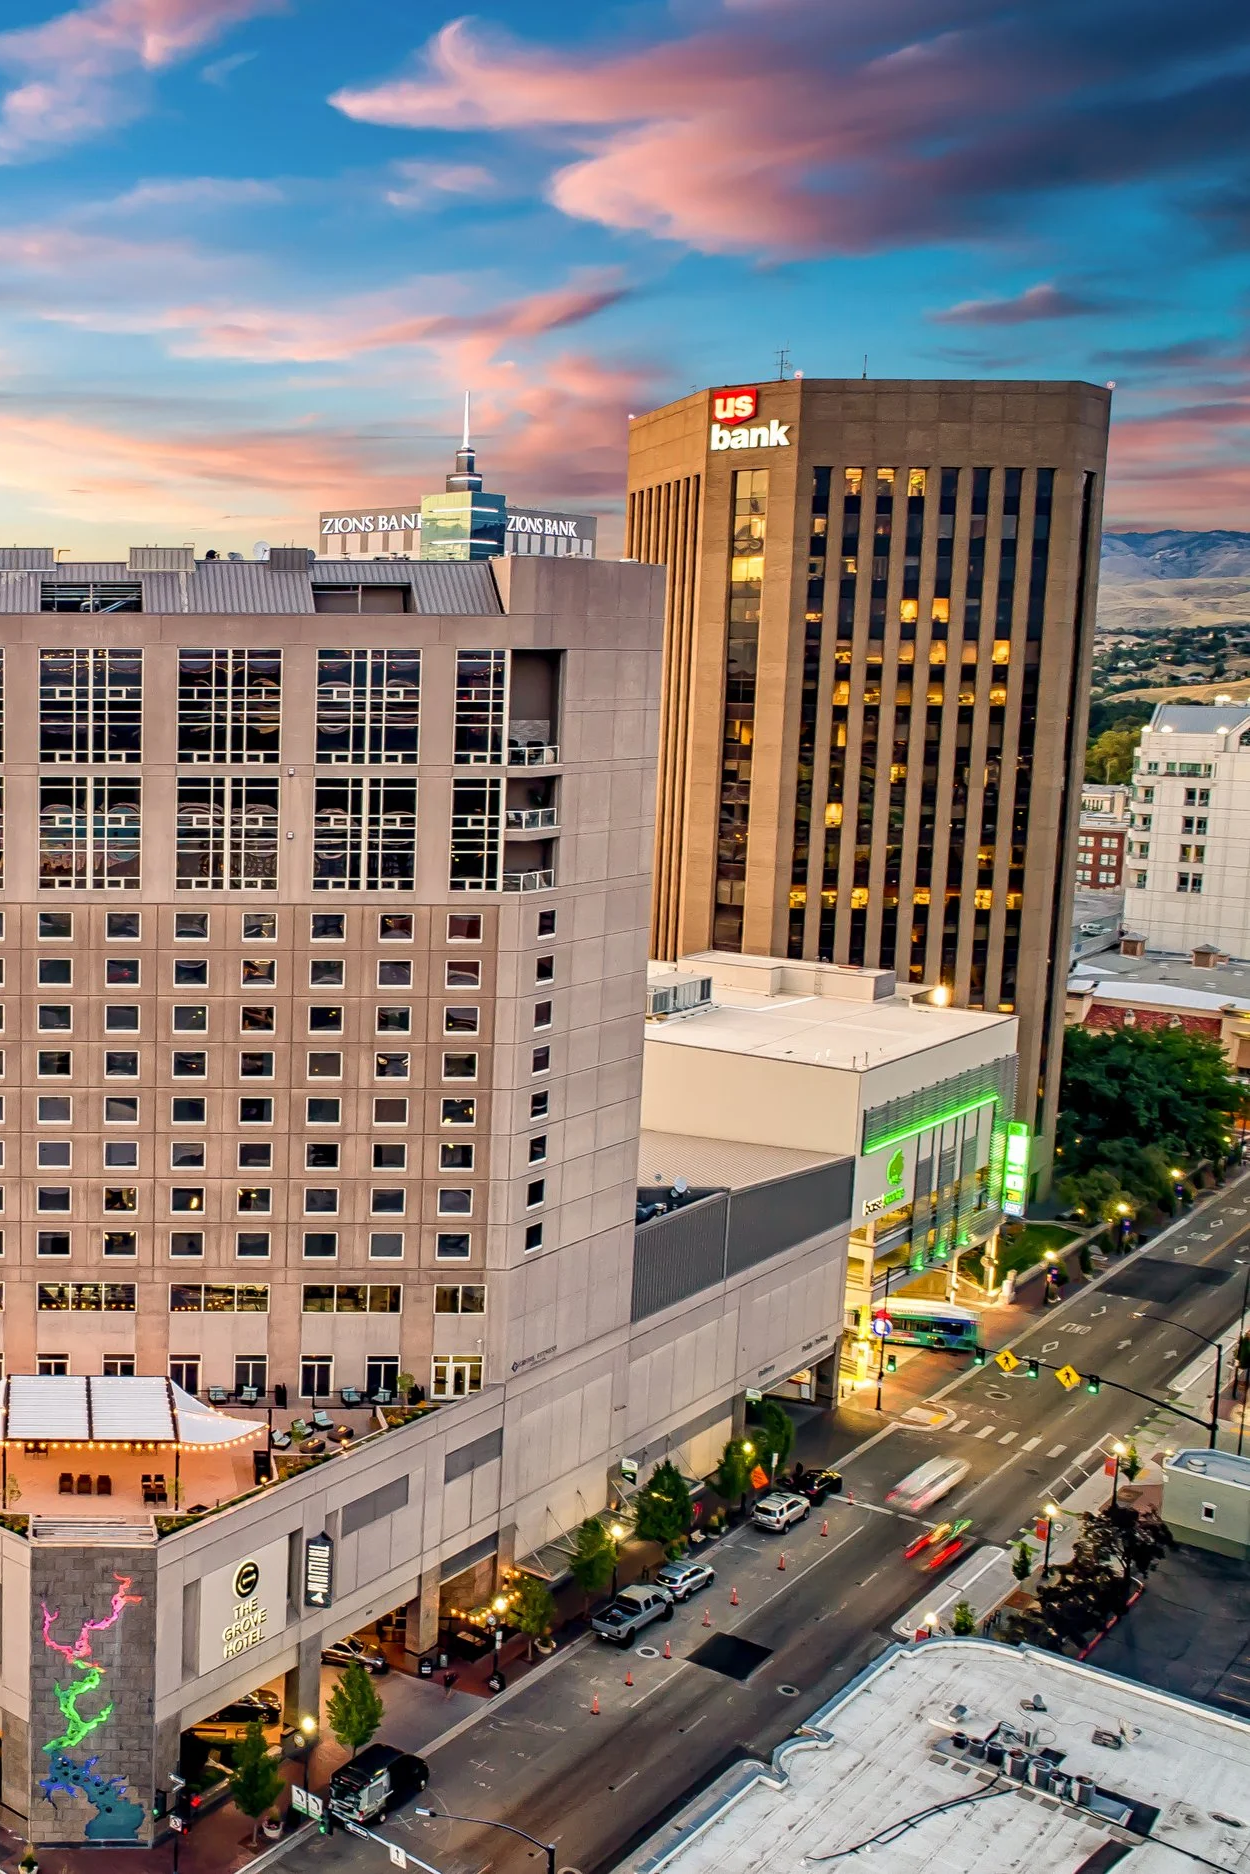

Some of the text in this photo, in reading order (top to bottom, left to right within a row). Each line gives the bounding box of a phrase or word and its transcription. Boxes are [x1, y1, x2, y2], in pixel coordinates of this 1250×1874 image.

[714, 395, 754, 419] us
[710, 419, 791, 451] bank
[321, 516, 375, 535] ZIONS
[506, 515, 578, 538] ZIONS BANK
[307, 1545, 330, 1593] TRILLIUM
[233, 1597, 258, 1620] THE
[222, 1608, 268, 1643] GROVE
[223, 1627, 266, 1659] HOTEL
